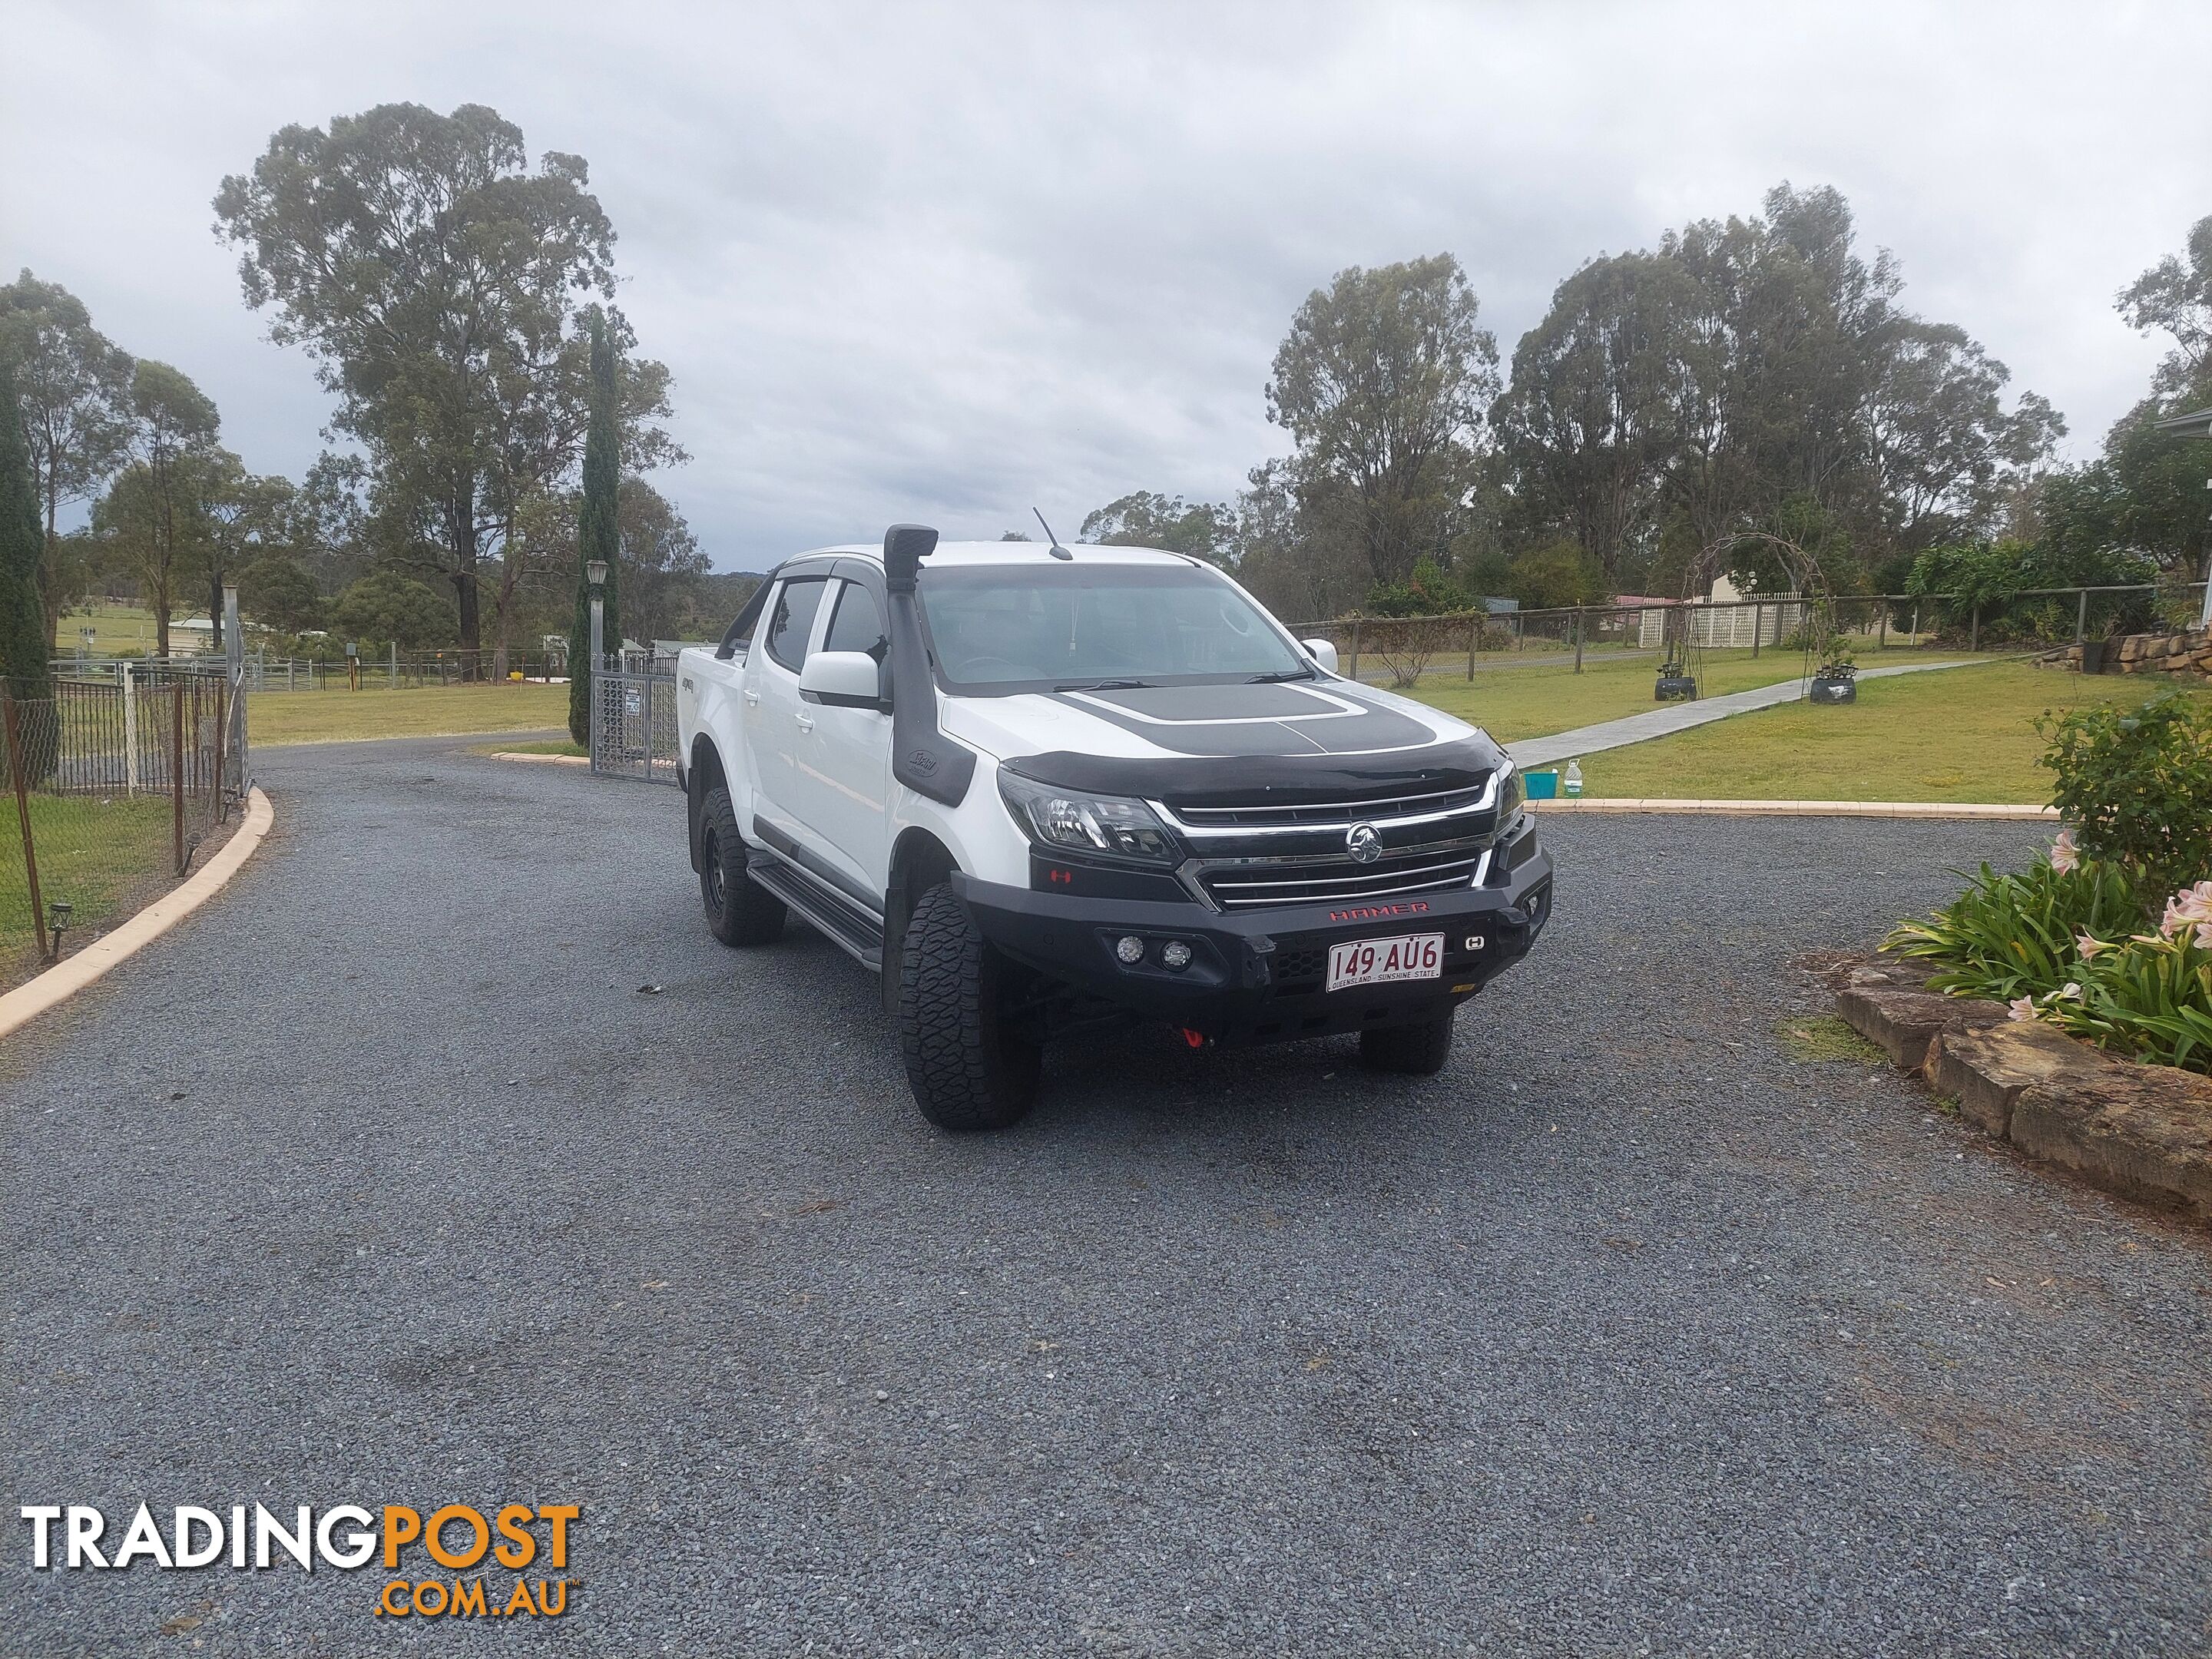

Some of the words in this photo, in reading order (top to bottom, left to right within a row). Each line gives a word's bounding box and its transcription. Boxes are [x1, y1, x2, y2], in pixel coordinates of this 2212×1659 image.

[1330, 901, 1431, 921] HAMER
[1382, 939, 1437, 972] AU6
[1332, 976, 1372, 989] QUEENSLAND
[1377, 971, 1412, 982] SUNSHINE
[1415, 969, 1435, 978] STATE
